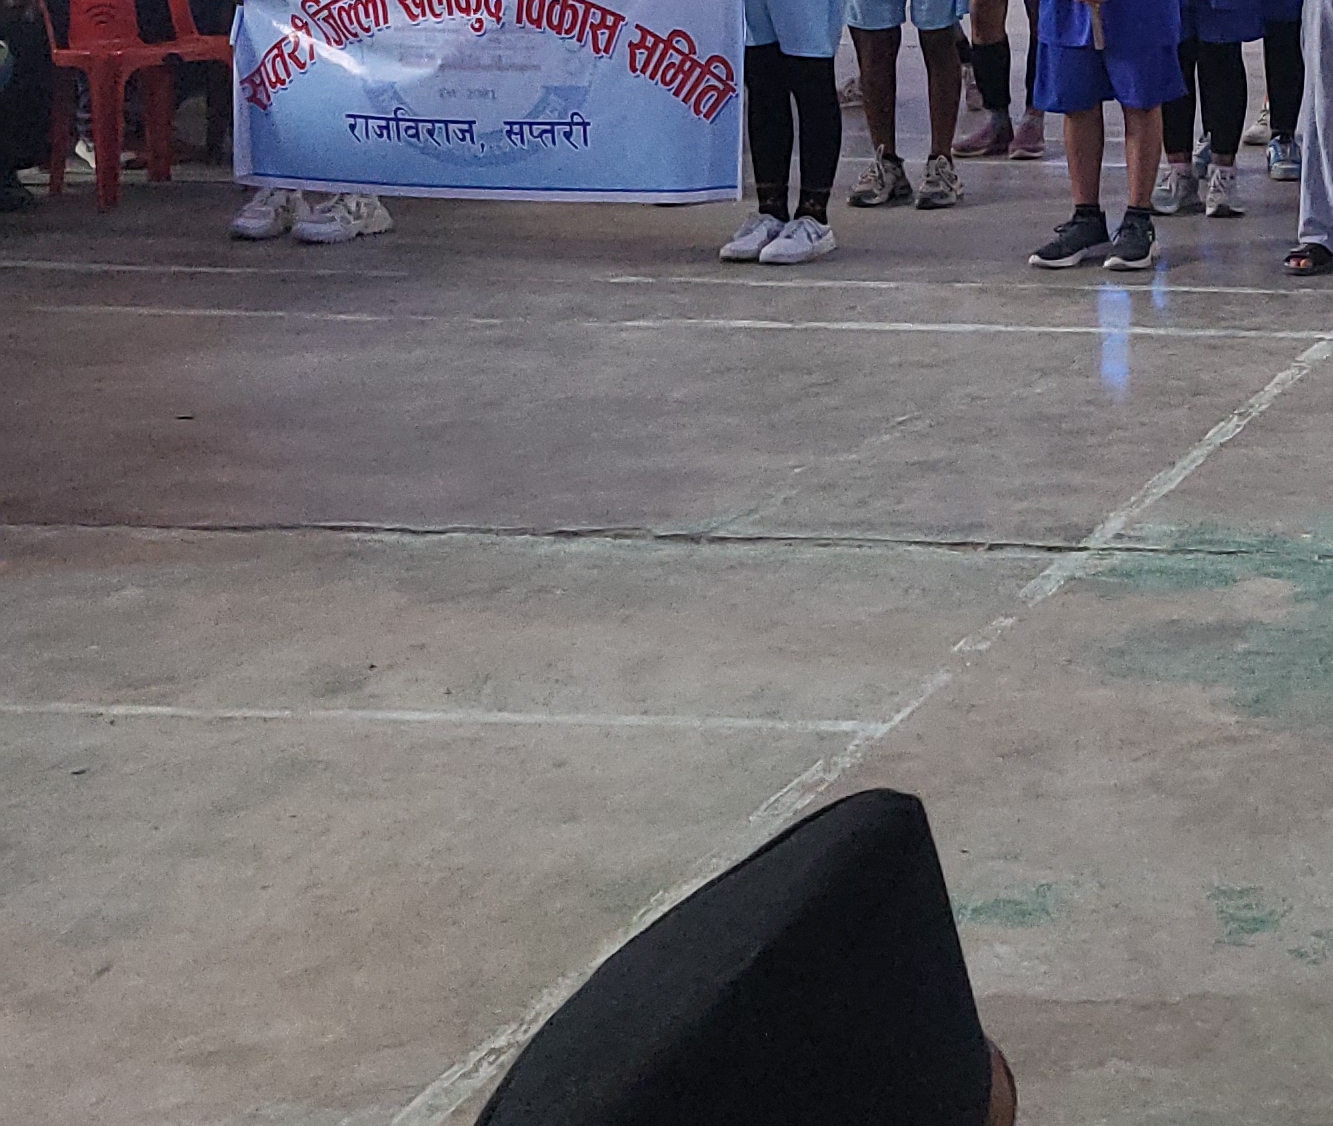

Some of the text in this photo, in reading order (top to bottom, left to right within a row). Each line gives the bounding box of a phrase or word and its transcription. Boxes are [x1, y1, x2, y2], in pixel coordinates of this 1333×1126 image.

[239, 13, 317, 111] सप्तरी
[627, 21, 738, 124] समिति
[345, 106, 592, 153] राजविराज, सप्तरी
